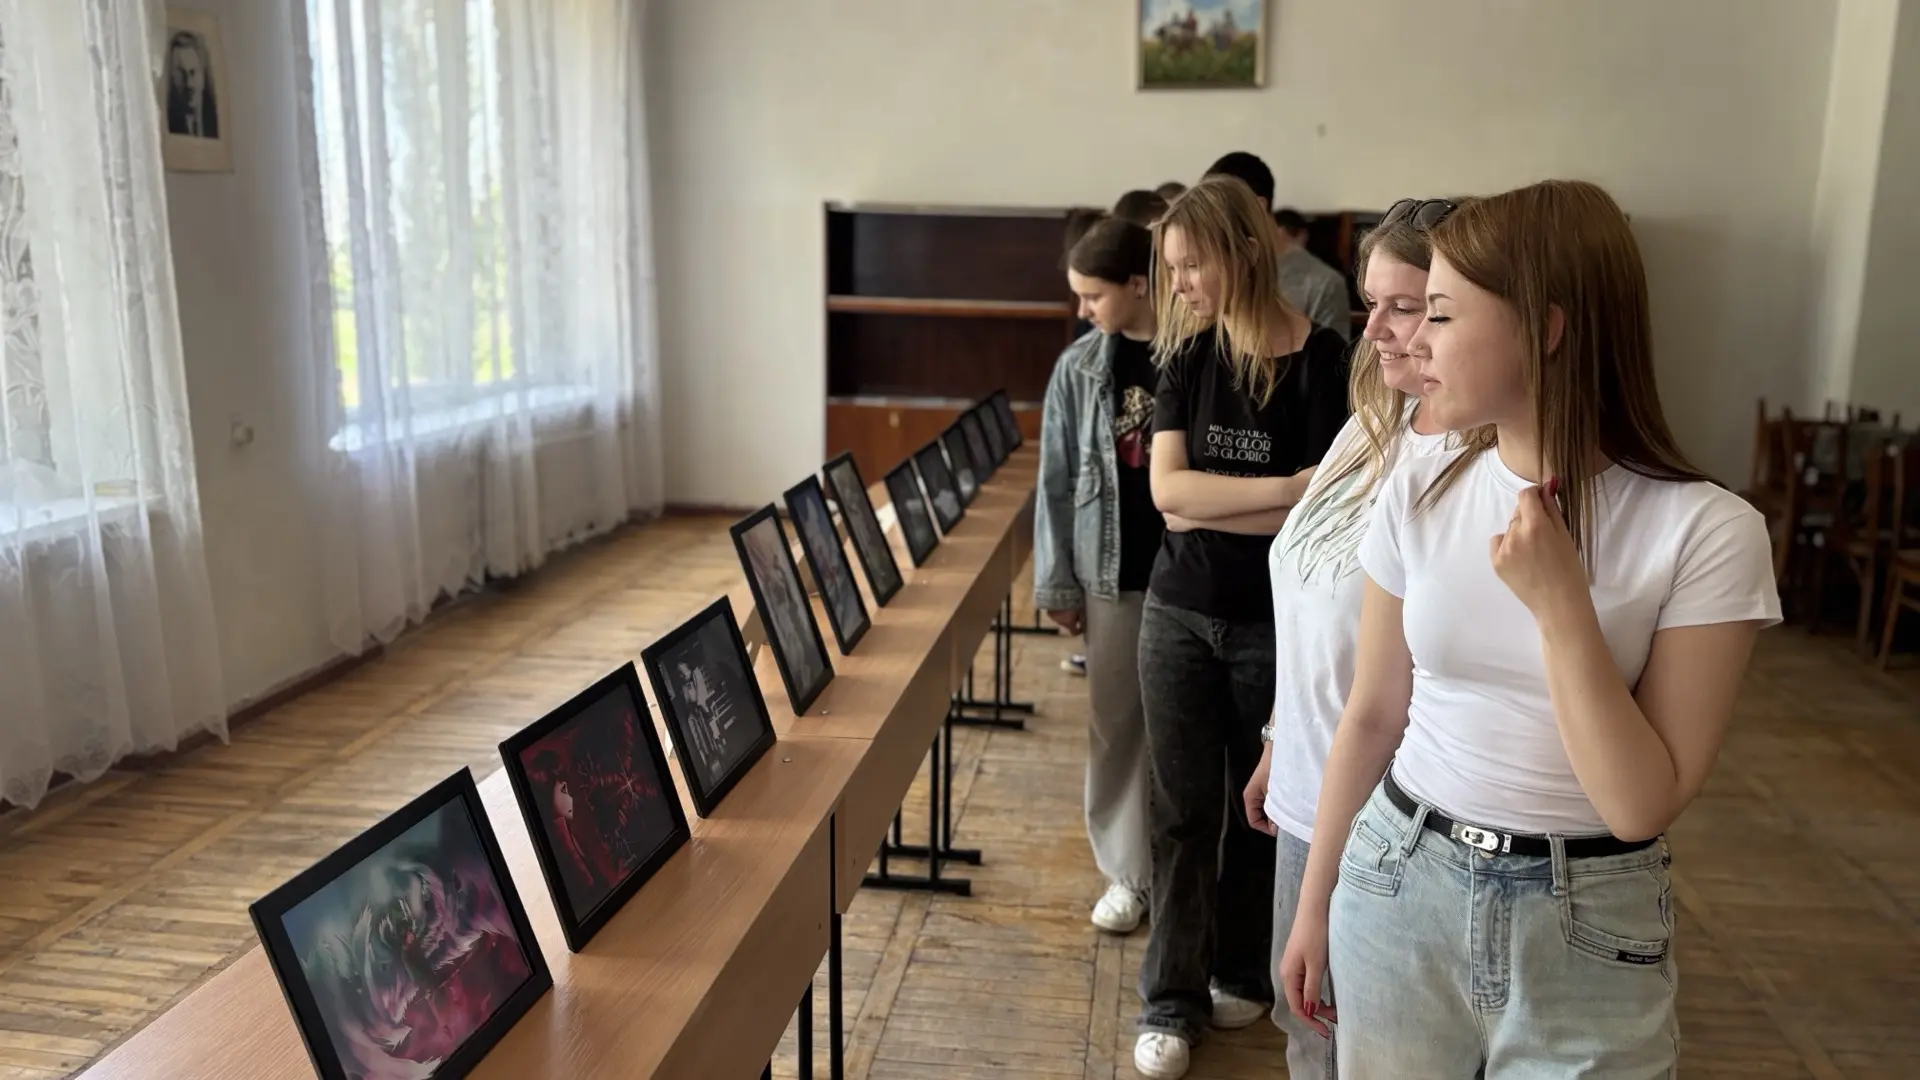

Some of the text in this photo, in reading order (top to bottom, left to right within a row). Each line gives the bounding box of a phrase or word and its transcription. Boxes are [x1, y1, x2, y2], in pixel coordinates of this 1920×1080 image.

[1207, 432, 1271, 452] OUS GLOR
[1220, 447, 1270, 463] GLORIO
